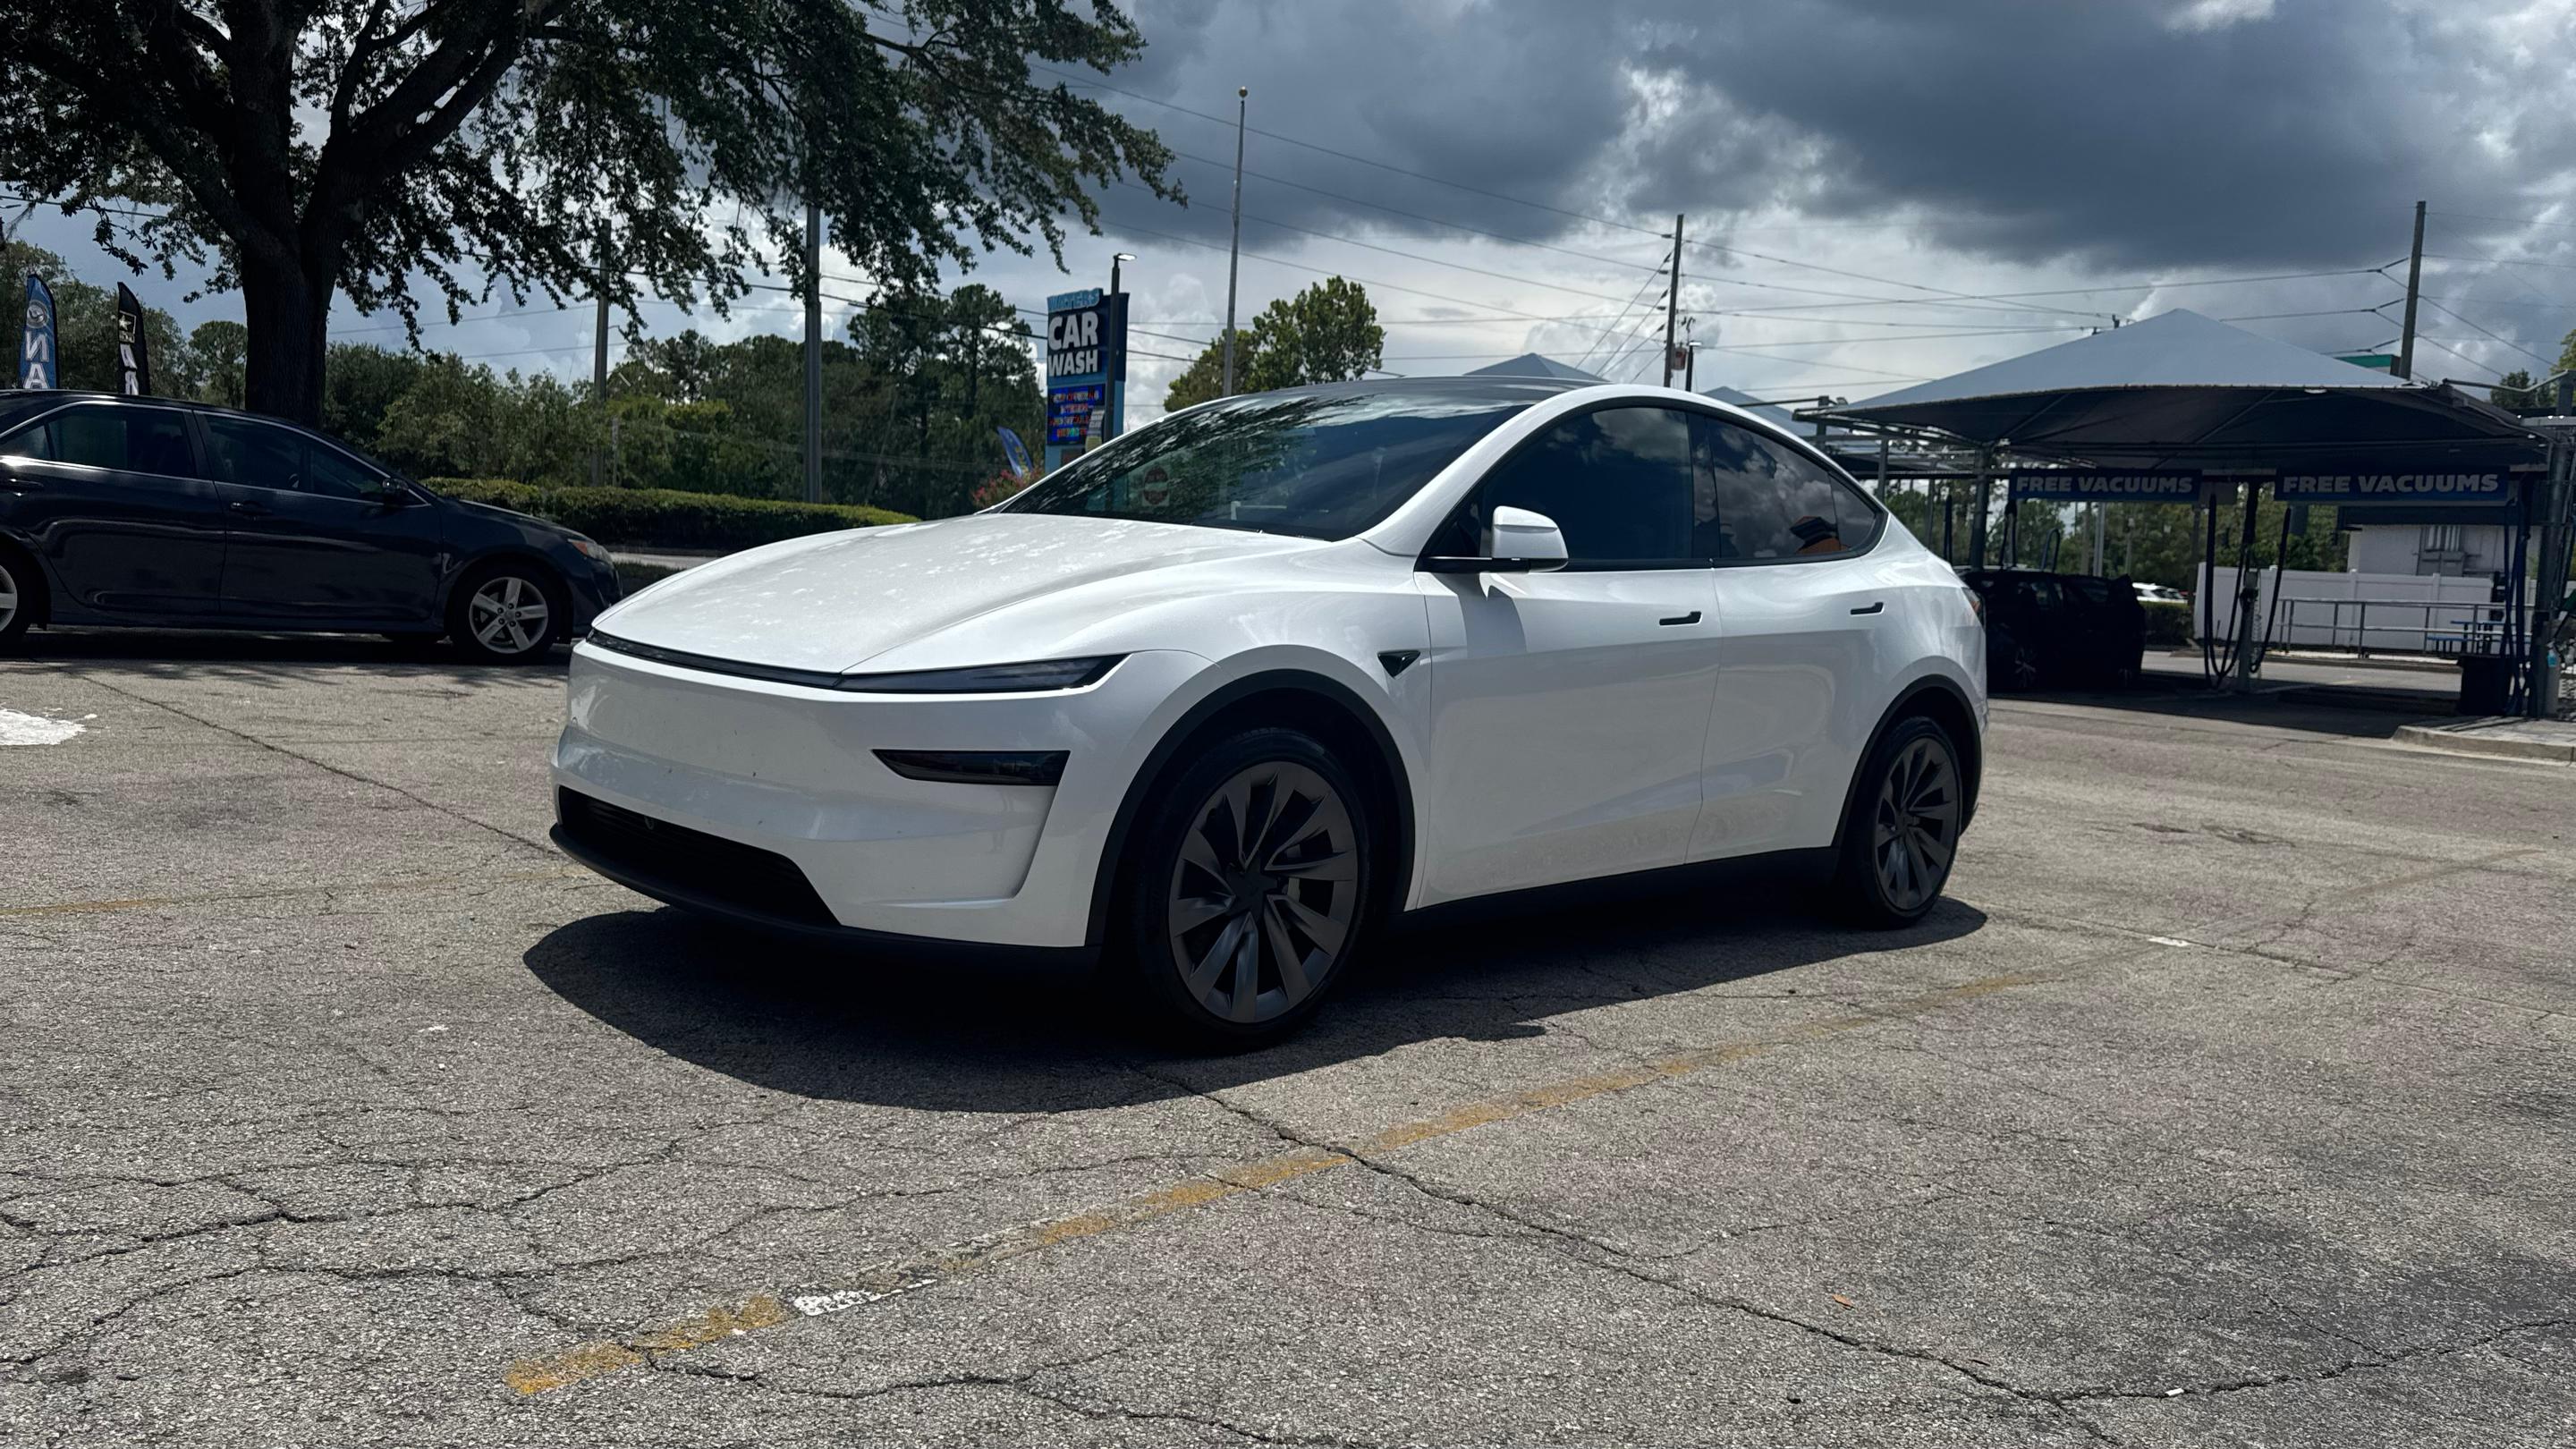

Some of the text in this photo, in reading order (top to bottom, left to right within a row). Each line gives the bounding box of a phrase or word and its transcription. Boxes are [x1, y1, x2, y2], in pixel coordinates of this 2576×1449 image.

[1048, 311, 1098, 351] CAR
[1047, 349, 1098, 377] WASH
[2016, 476, 2192, 493] FREE VACUUMS
[2283, 474, 2498, 493] FREE VACUUMS
